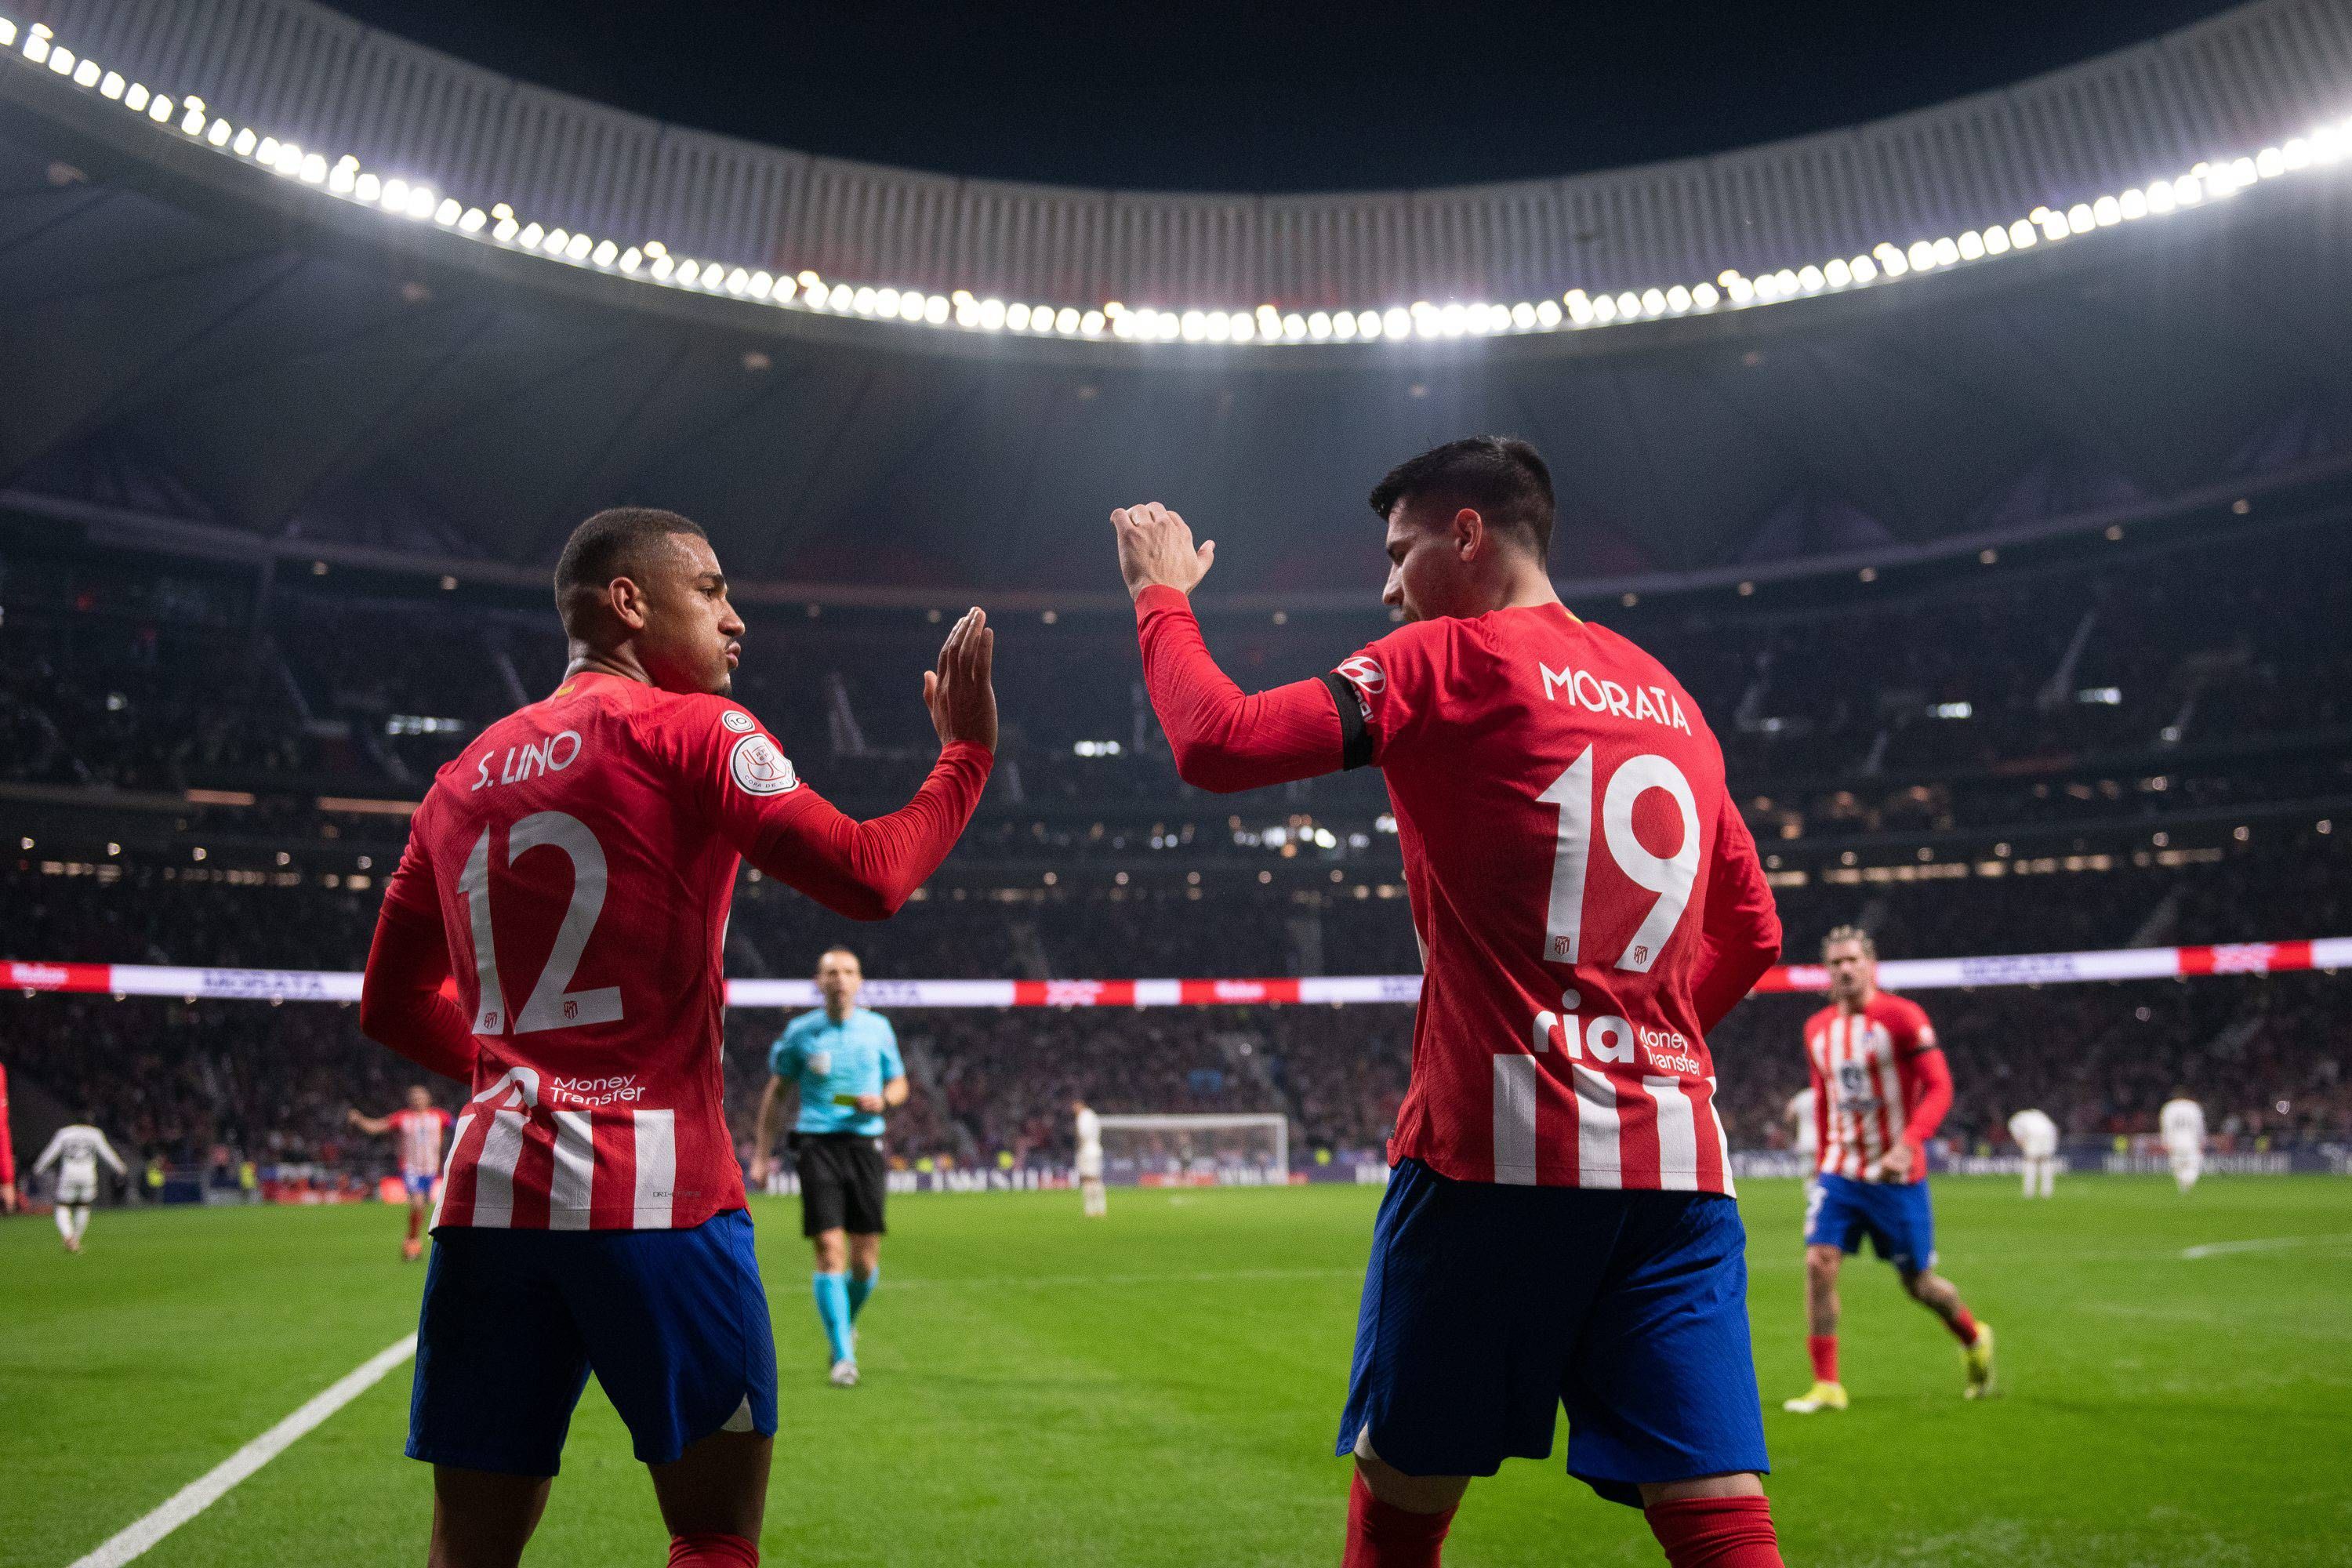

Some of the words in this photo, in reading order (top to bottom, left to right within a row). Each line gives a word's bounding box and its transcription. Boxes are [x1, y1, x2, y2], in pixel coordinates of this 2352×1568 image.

[730, 717, 746, 726] 10
[1539, 662, 1692, 736] MORATA
[471, 750, 494, 791] S.
[500, 730, 583, 785] LINO
[744, 775, 762, 789] COPA
[1534, 742, 1700, 974] 19
[457, 810, 624, 1035] 12
[1533, 989, 1635, 1063] ria
[550, 1085, 646, 1106] Transfer
[553, 1073, 637, 1092] Money
